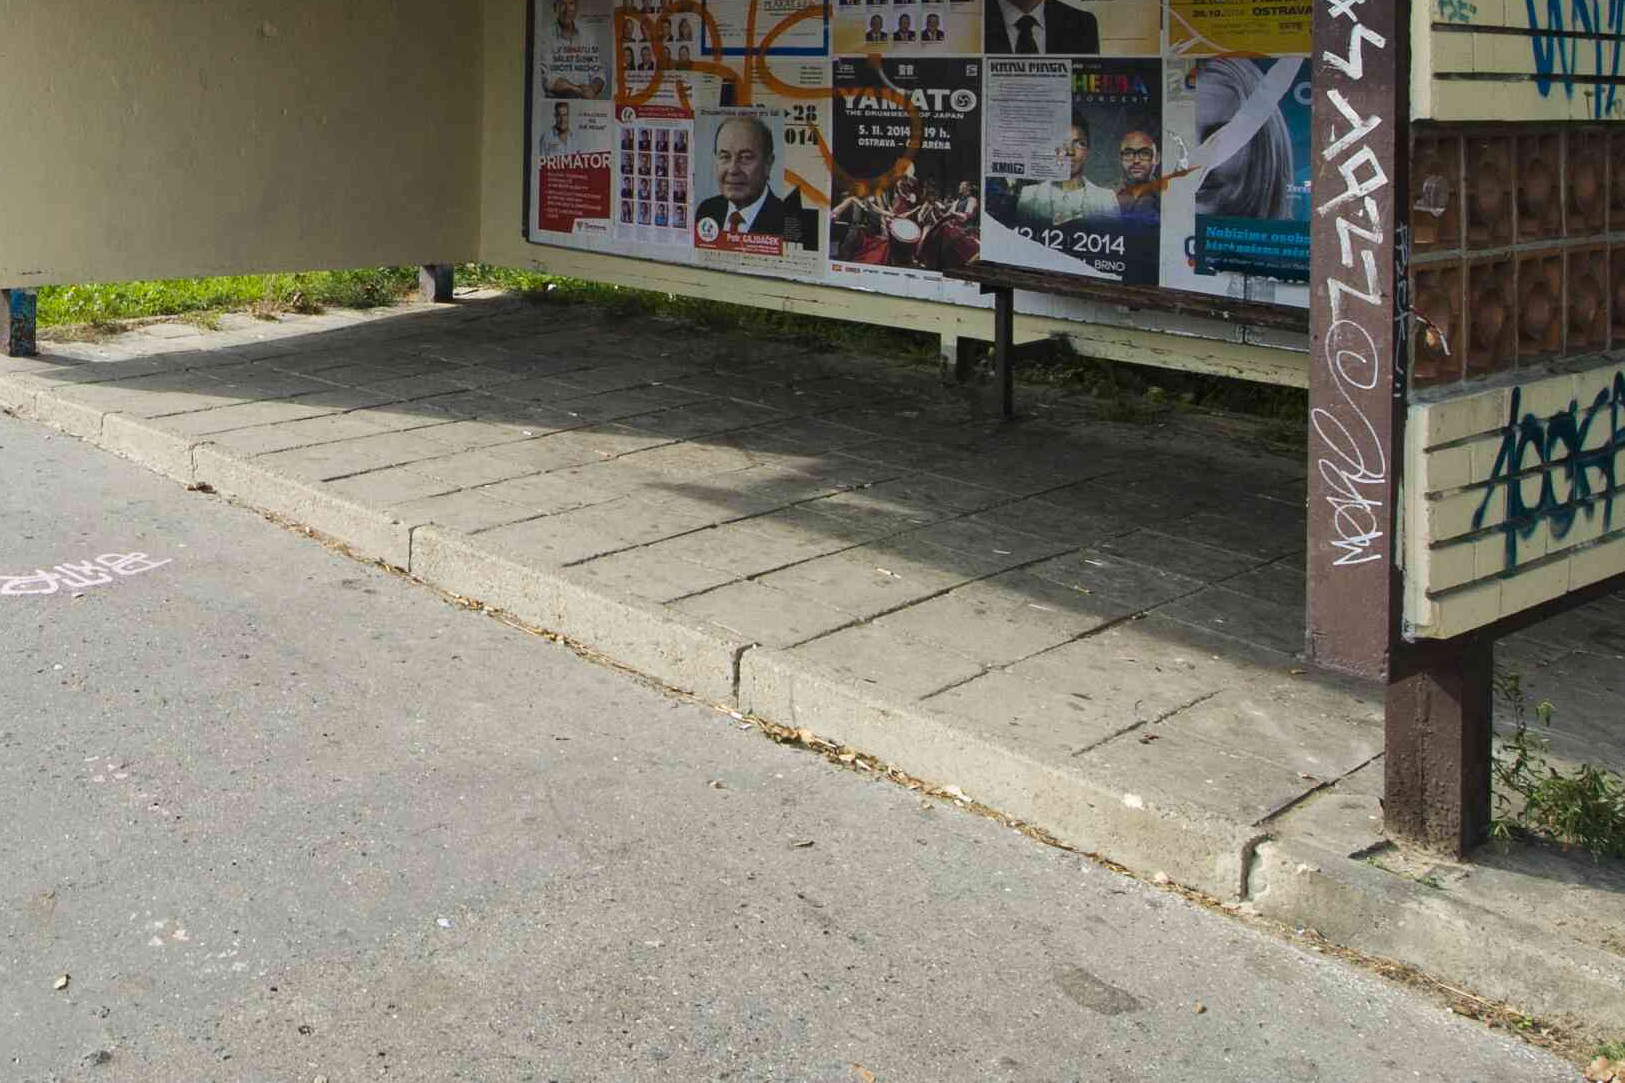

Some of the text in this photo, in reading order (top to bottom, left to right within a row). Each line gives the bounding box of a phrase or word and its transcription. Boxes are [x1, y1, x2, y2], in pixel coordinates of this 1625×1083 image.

[1252, 5, 1312, 17] OSTRAVA
[857, 137, 896, 148] OSTRAVA
[1072, 231, 1126, 256] 2014
[1094, 259, 1126, 272] BRNO
